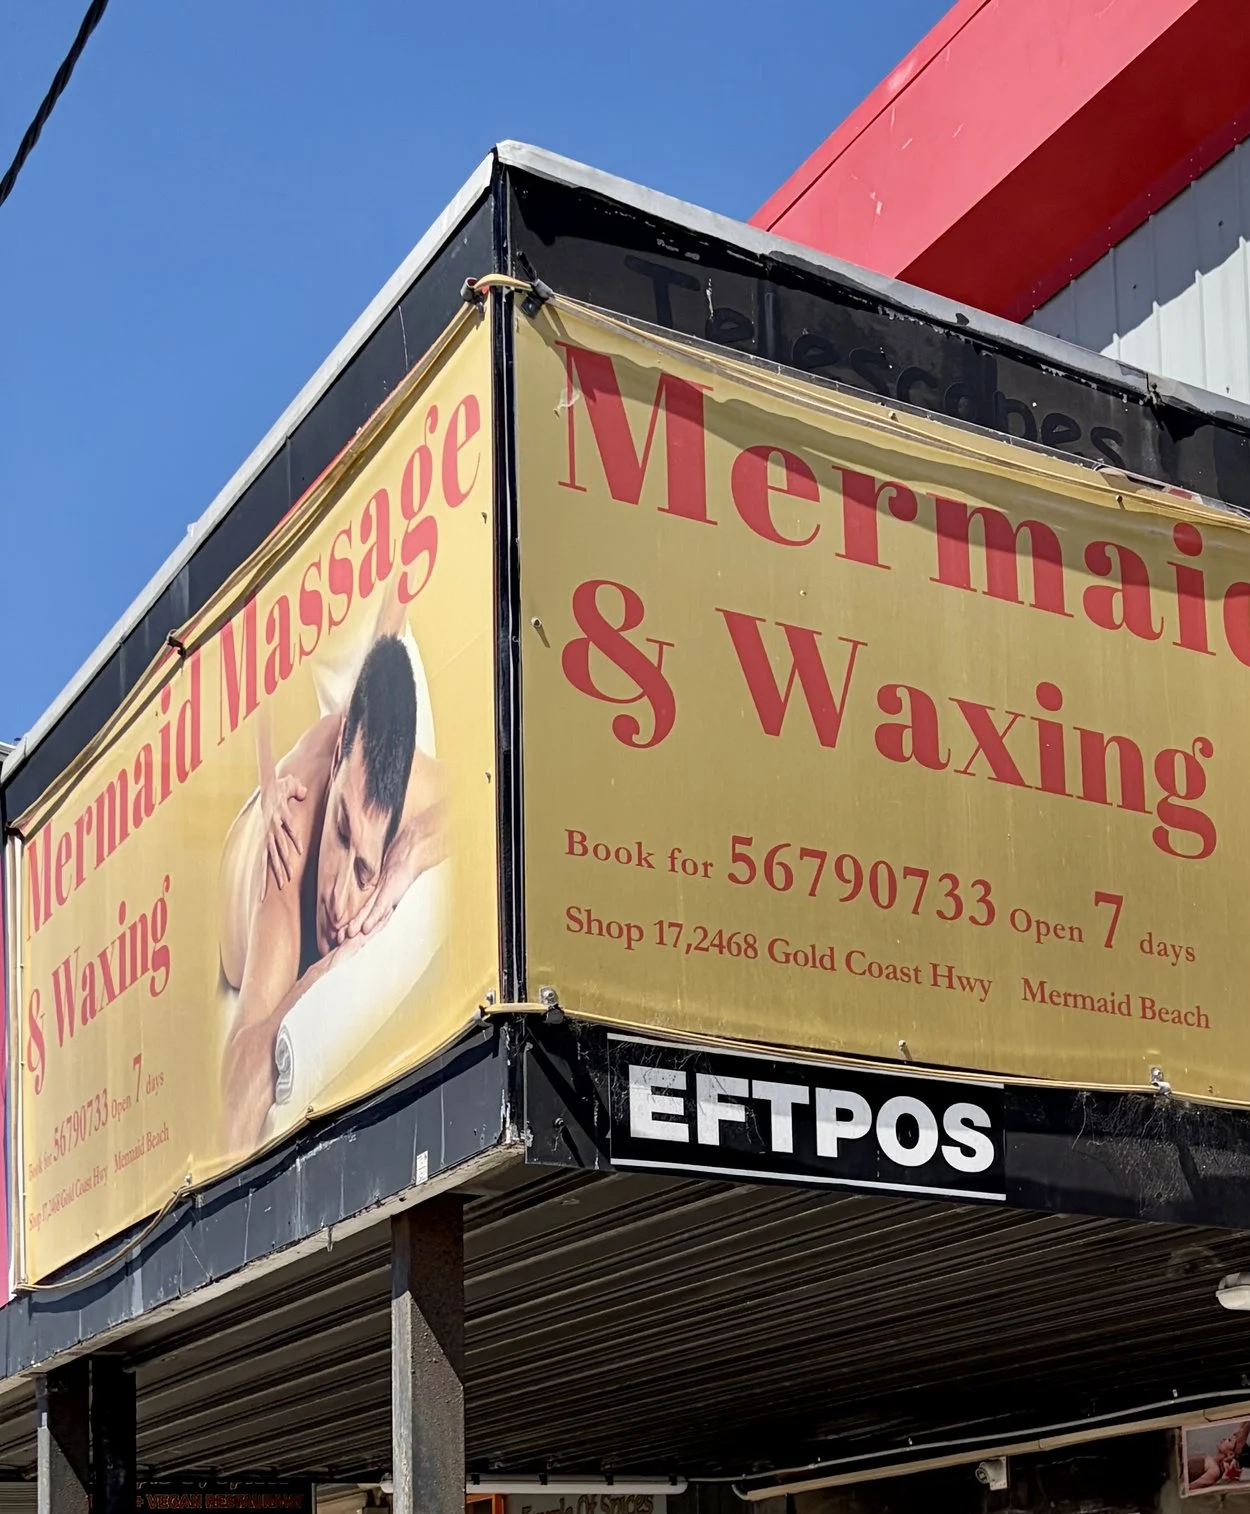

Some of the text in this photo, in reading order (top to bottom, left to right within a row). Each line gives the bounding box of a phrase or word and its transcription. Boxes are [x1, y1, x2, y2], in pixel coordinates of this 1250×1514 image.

[25, 393, 482, 943] Mermaid Massage
[559, 579, 1218, 860] & Waxing
[565, 829, 1196, 965] Book for 56790733 Open 7 days
[26, 874, 171, 1095] & Waxing
[565, 906, 1211, 1030] Shop 17,2468 Gold Coast Hwy Mermaid Beach
[54, 1087, 110, 1162] 56790733
[111, 1095, 132, 1122] Open
[132, 1053, 142, 1103] 7
[146, 1072, 165, 1095] days
[93, 1164, 109, 1187] Hwy
[114, 1133, 146, 1174] Mermaid
[146, 1122, 170, 1152] Beach
[628, 1064, 995, 1173] EFTPOS
[145, 1493, 203, 1510] VEGAN
